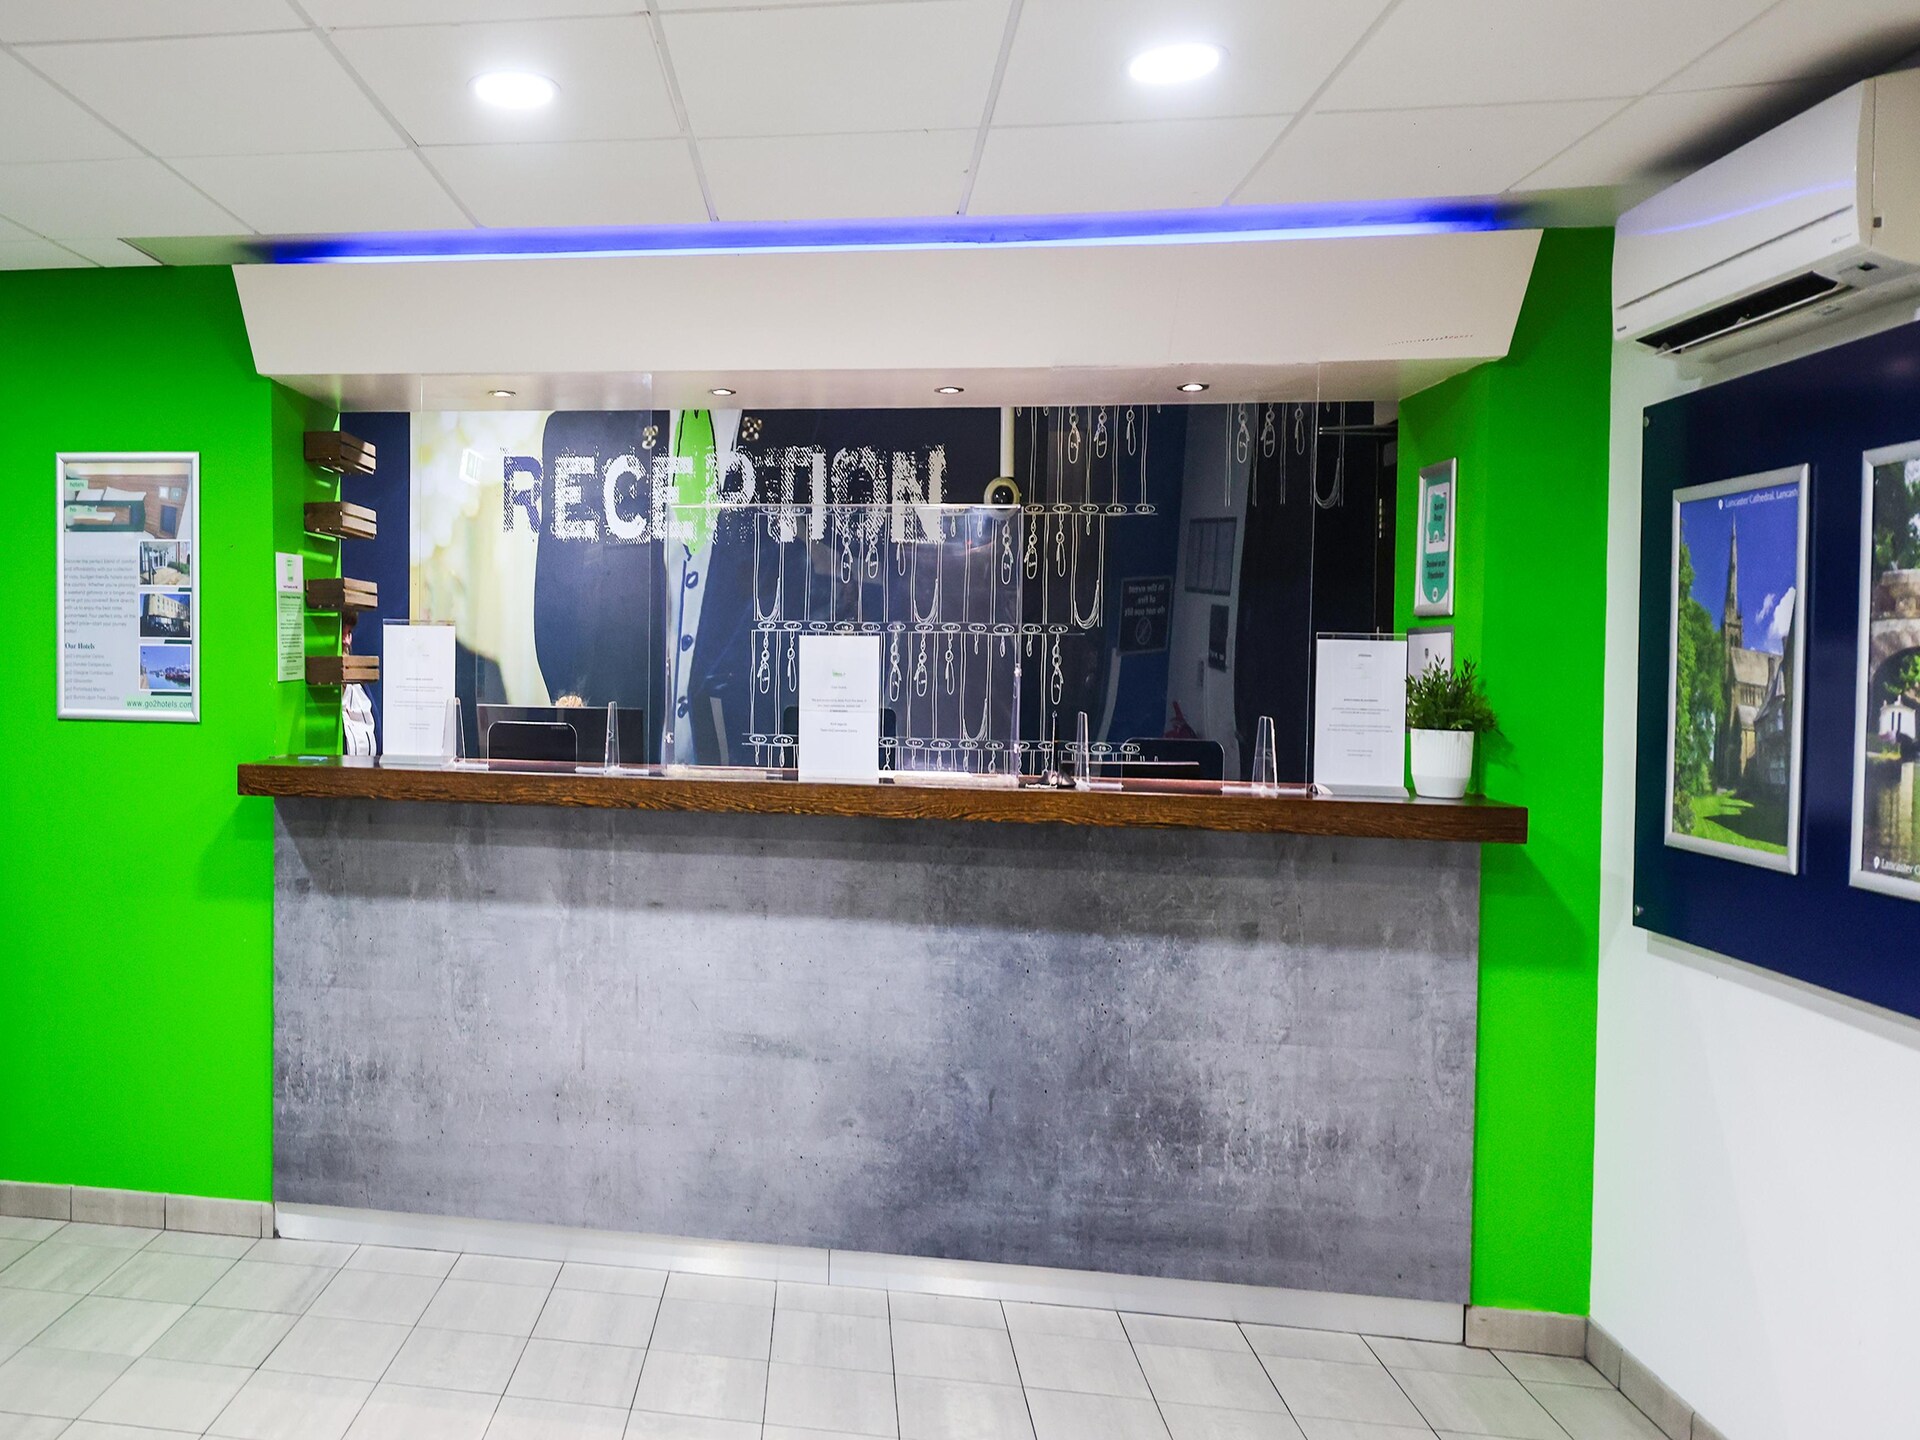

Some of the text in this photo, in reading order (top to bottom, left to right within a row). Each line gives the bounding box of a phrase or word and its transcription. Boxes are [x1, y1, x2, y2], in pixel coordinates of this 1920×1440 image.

[499, 445, 948, 545] RECEPTION
[1724, 496, 1749, 508] Lancaster
[77, 642, 95, 650] Hotels
[1881, 858, 1914, 874] Lancaster
